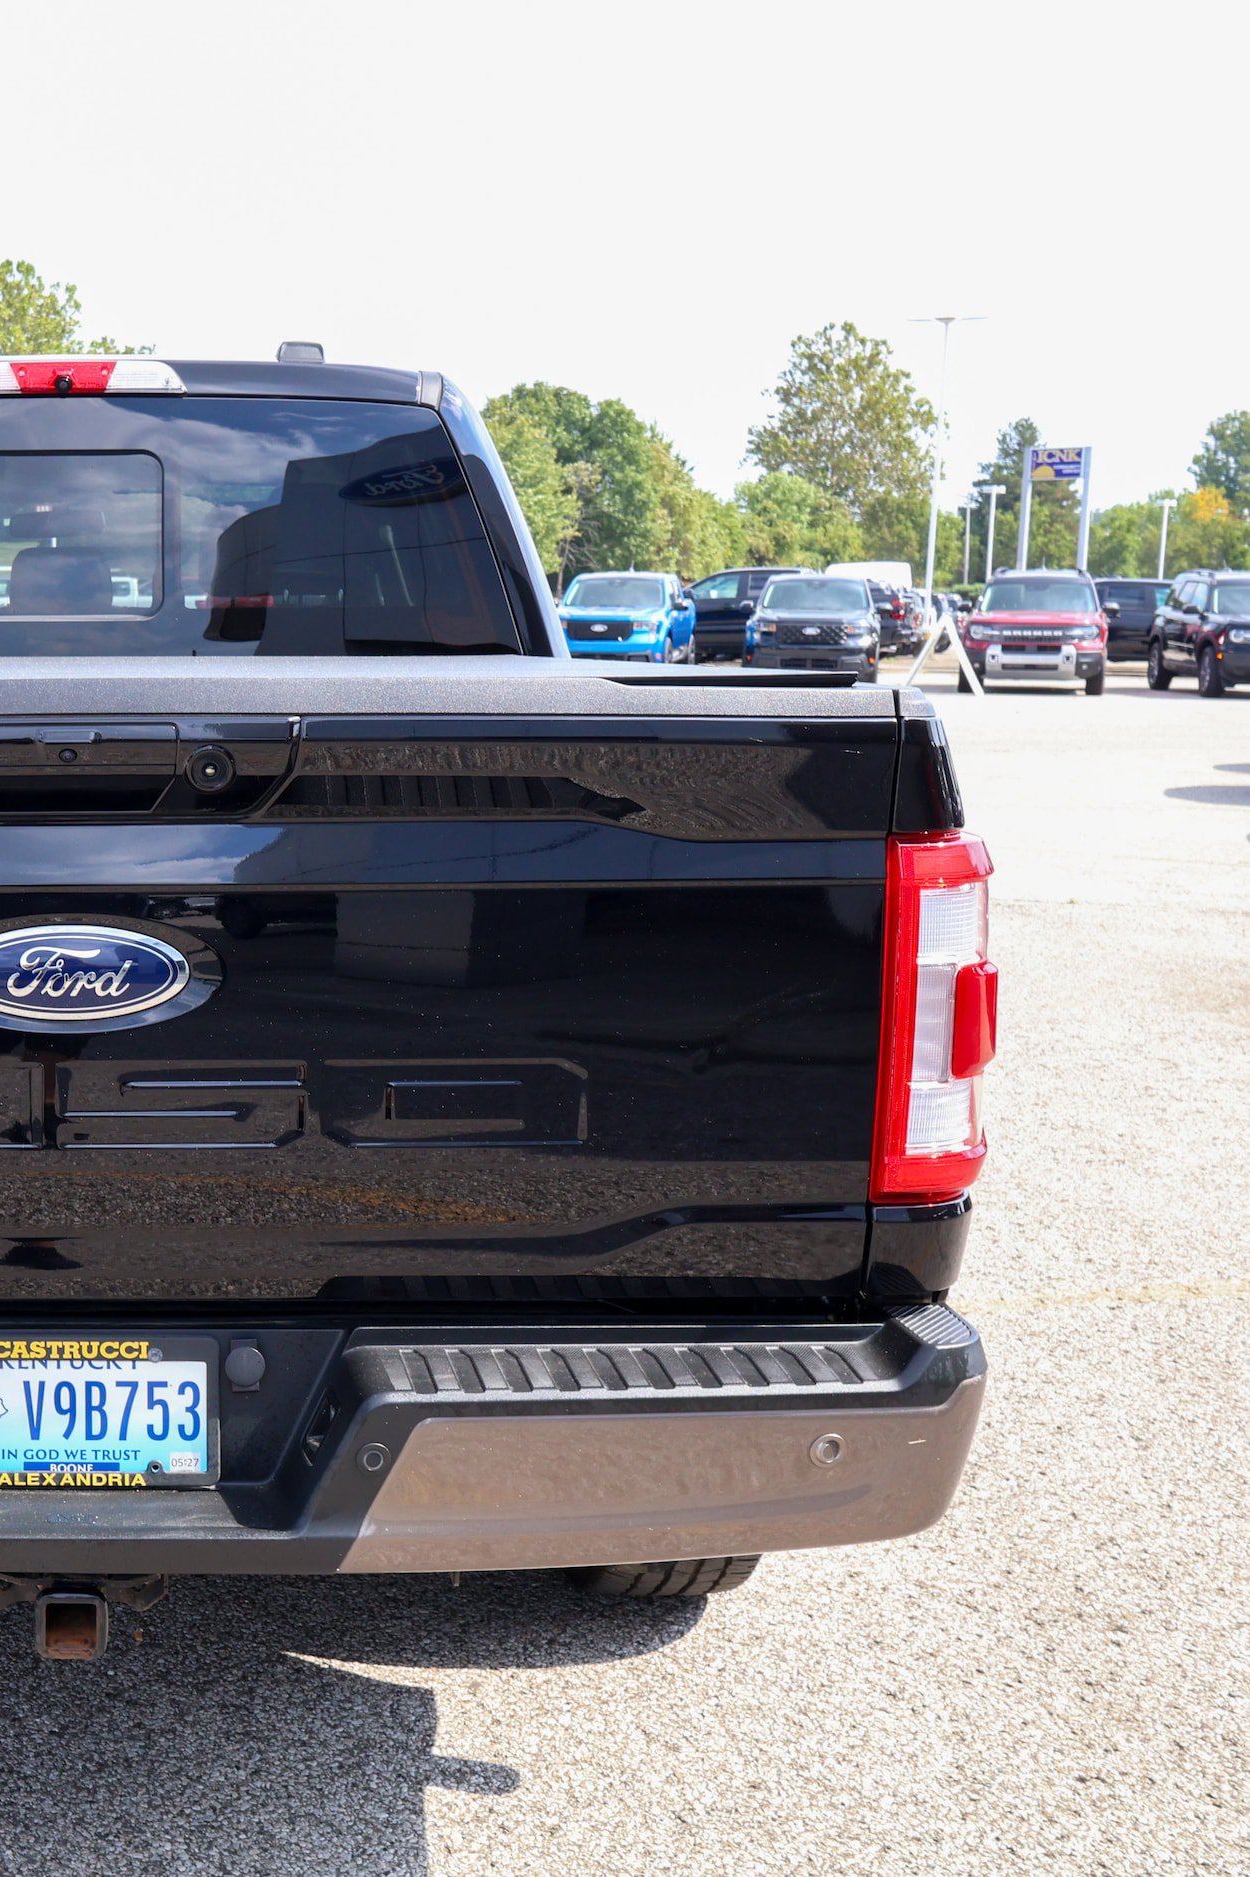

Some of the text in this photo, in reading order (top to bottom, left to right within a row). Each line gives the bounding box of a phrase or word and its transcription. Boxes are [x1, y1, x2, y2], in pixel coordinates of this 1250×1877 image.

[6, 946, 134, 998] Ford
[22, 1380, 201, 1442] V9B753
[1, 1448, 141, 1461] IN GOD WE TRUST
